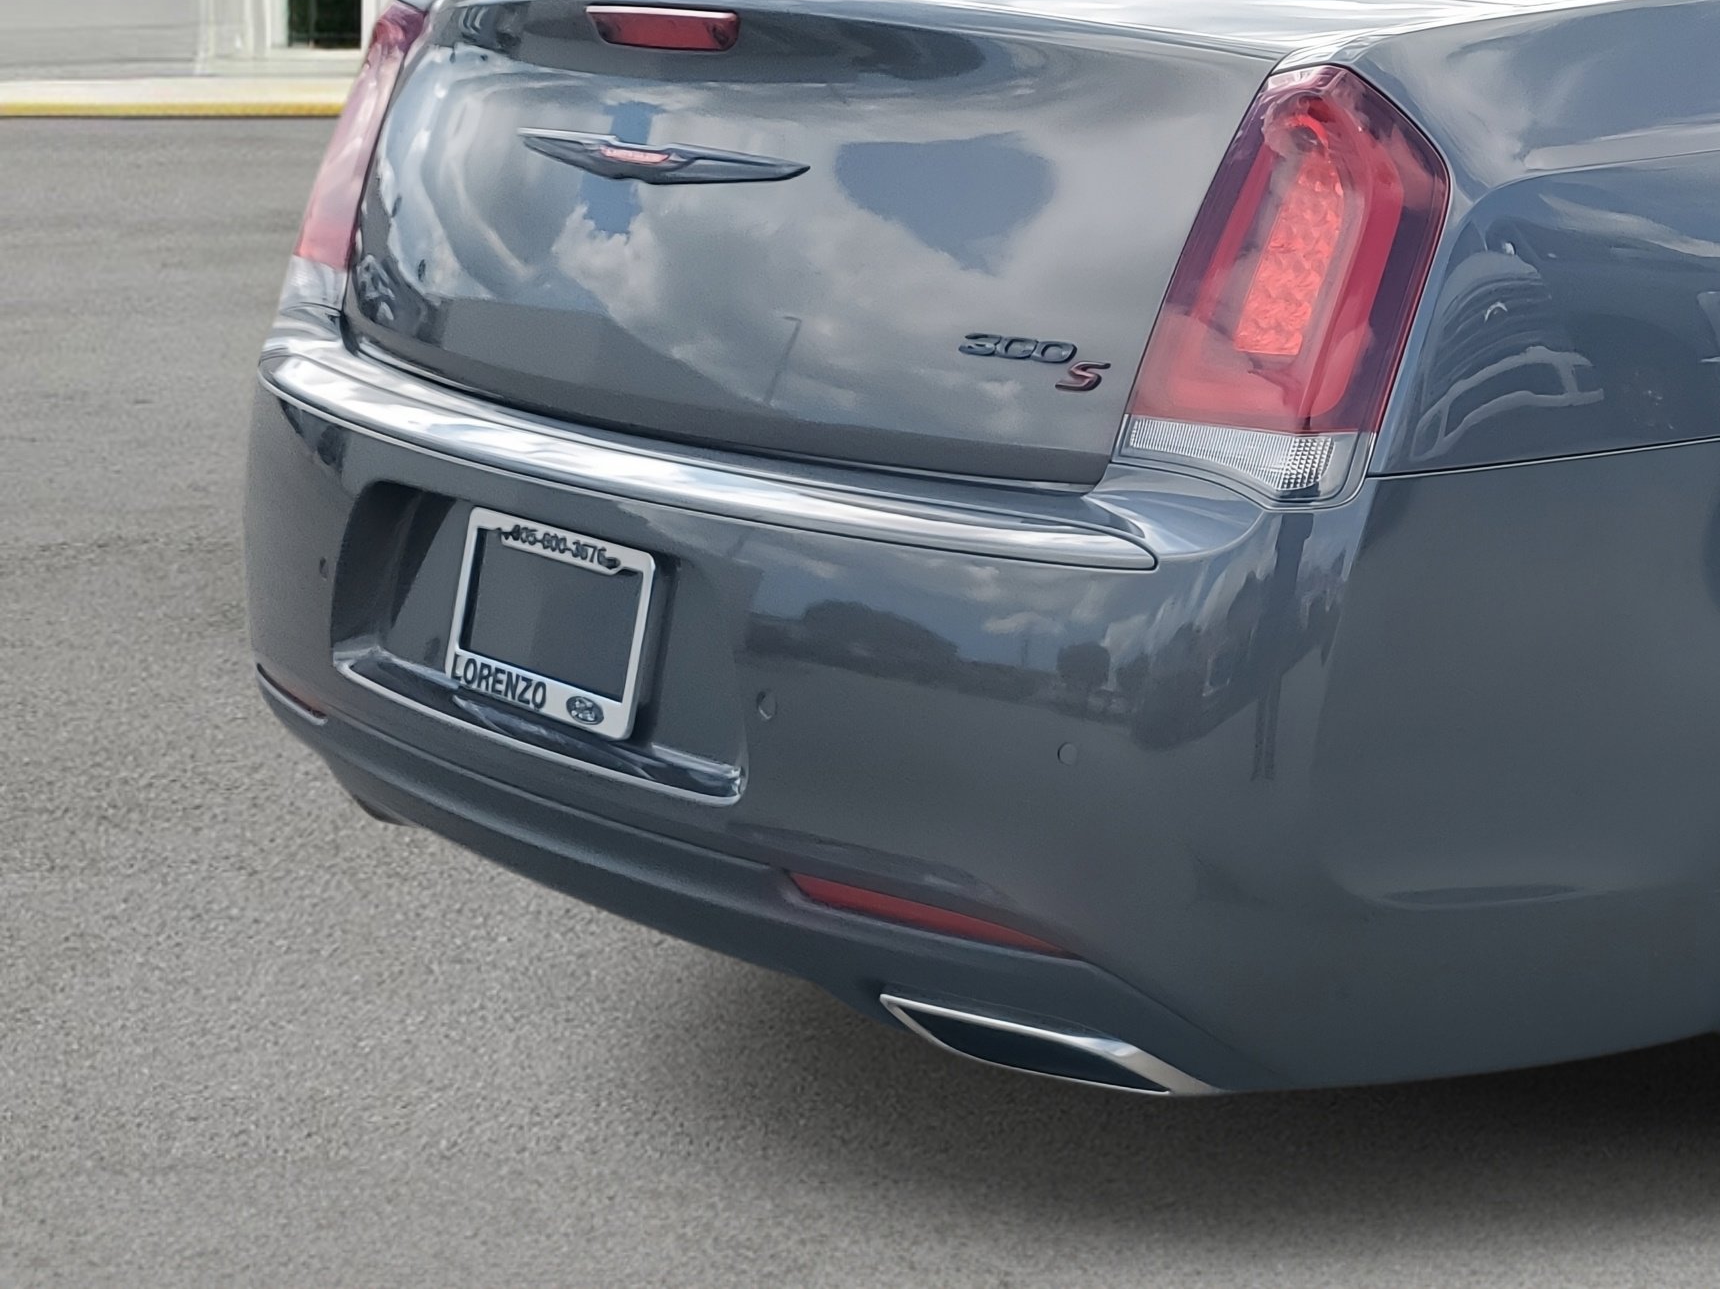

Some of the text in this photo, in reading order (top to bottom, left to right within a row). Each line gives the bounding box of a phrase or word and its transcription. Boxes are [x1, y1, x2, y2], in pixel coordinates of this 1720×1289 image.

[958, 332, 1112, 392] 300 S
[450, 651, 547, 710] LORENZO
